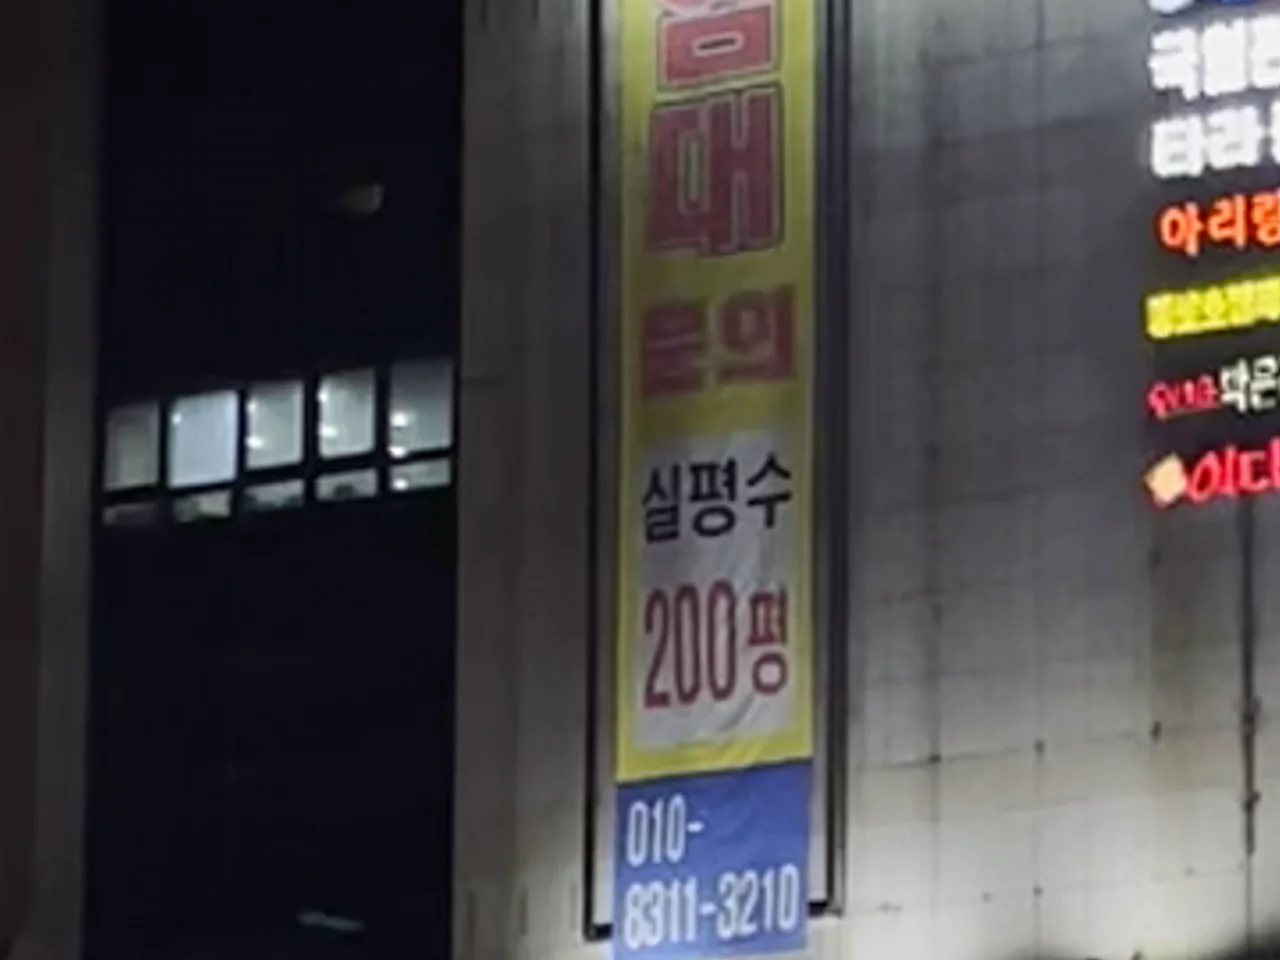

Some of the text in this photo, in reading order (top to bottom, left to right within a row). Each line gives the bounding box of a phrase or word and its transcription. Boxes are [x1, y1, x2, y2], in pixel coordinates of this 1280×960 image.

[641, 284, 796, 398] 문의
[643, 452, 793, 543] 실평수
[643, 579, 789, 709] 200평
[626, 793, 704, 867] 010-
[624, 862, 800, 949] 8311-3210
